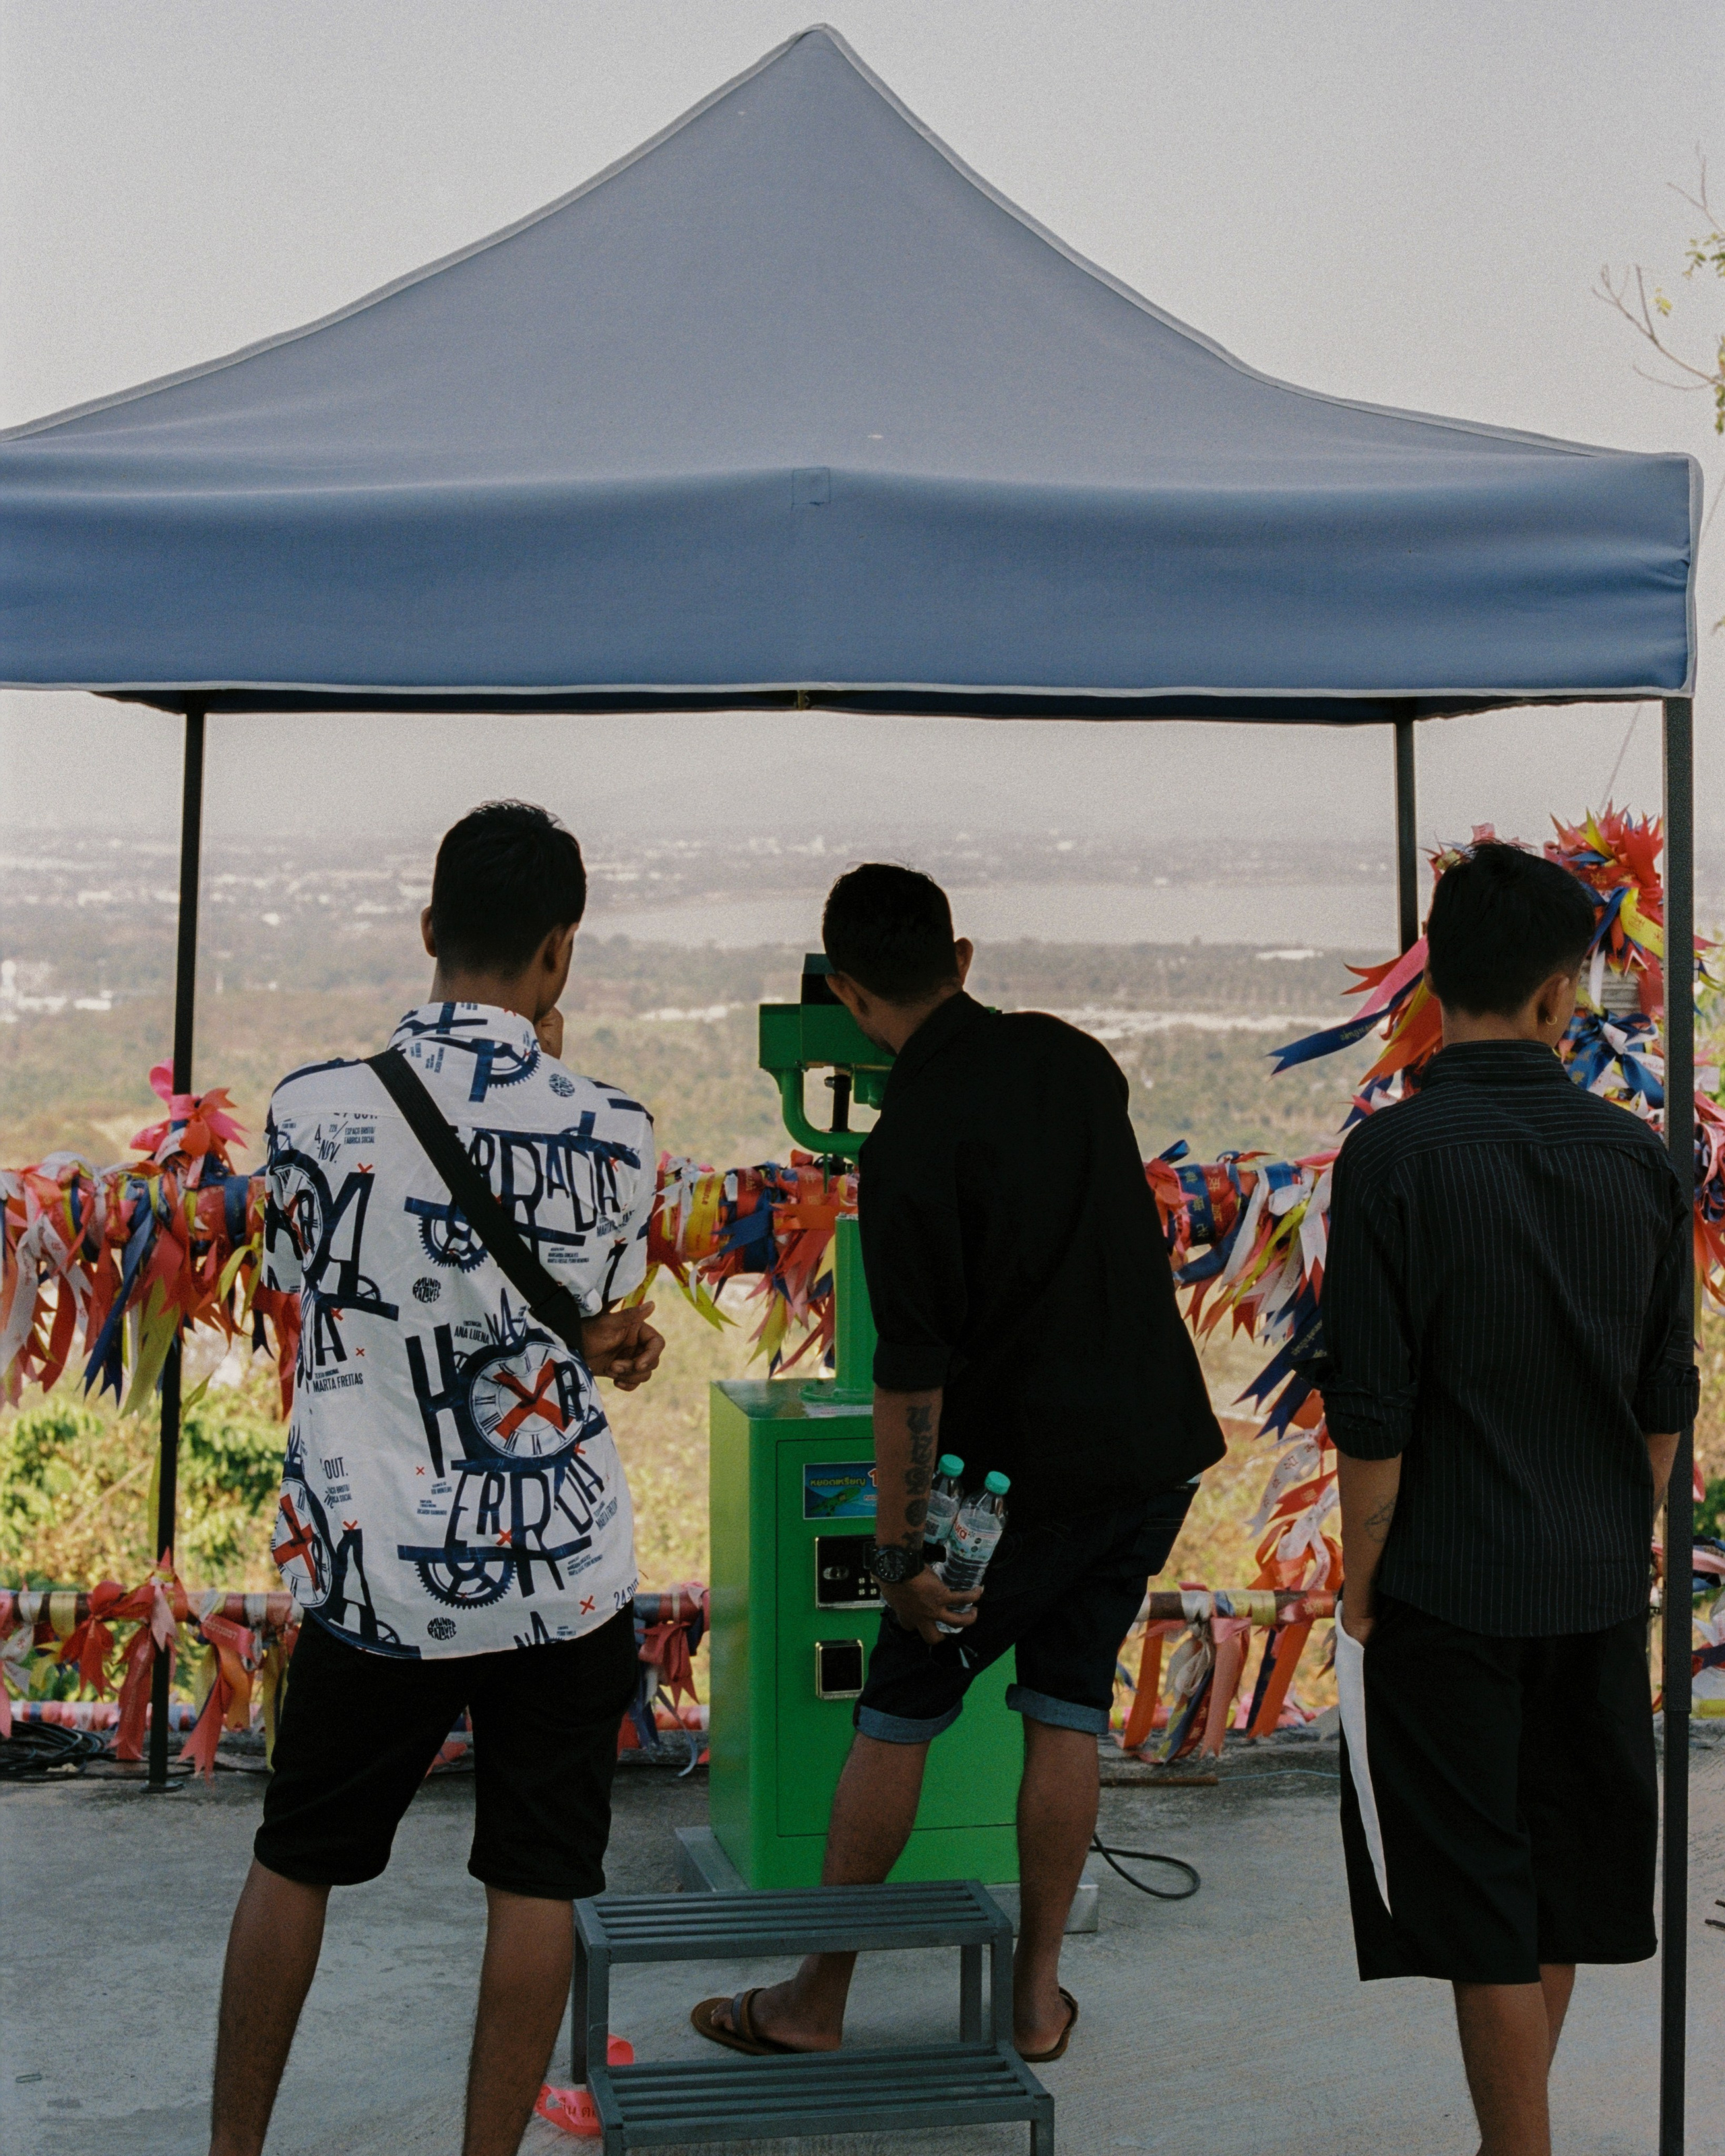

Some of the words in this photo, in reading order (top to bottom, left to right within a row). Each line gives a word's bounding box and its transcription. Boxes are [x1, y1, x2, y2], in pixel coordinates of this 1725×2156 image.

[454, 1325, 468, 1339] ANA
[469, 1329, 489, 1345] LUENA
[313, 1377, 336, 1393] MARTA
[337, 1372, 363, 1388] FREITAS
